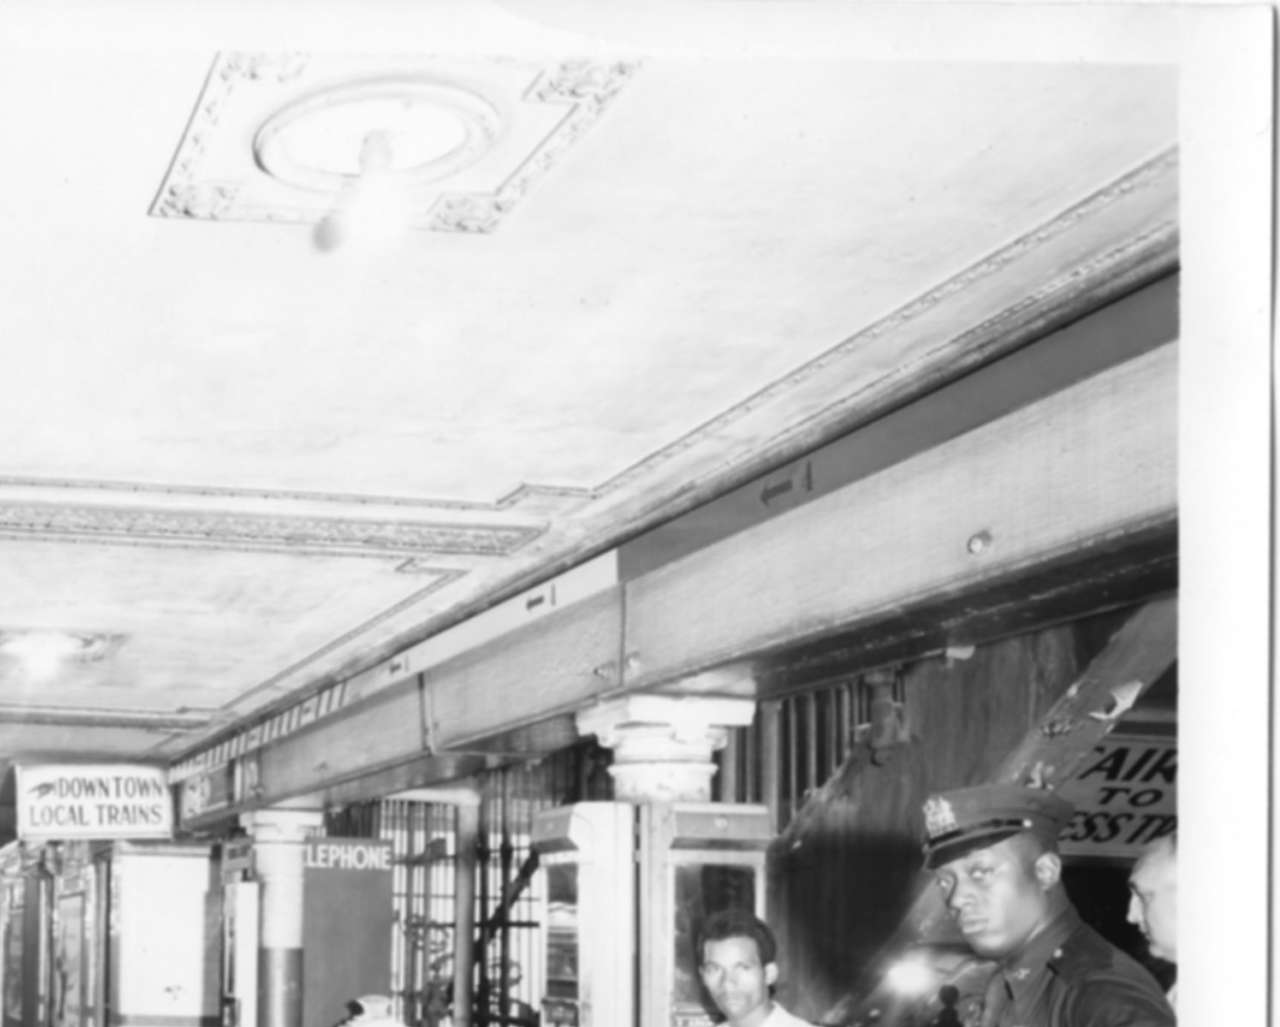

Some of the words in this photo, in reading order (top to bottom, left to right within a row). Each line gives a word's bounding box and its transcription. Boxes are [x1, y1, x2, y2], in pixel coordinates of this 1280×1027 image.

[1077, 747, 1177, 784] AIR
[1098, 786, 1163, 808] TO
[28, 803, 89, 827] LOCAL
[95, 803, 163, 826] TRAINS
